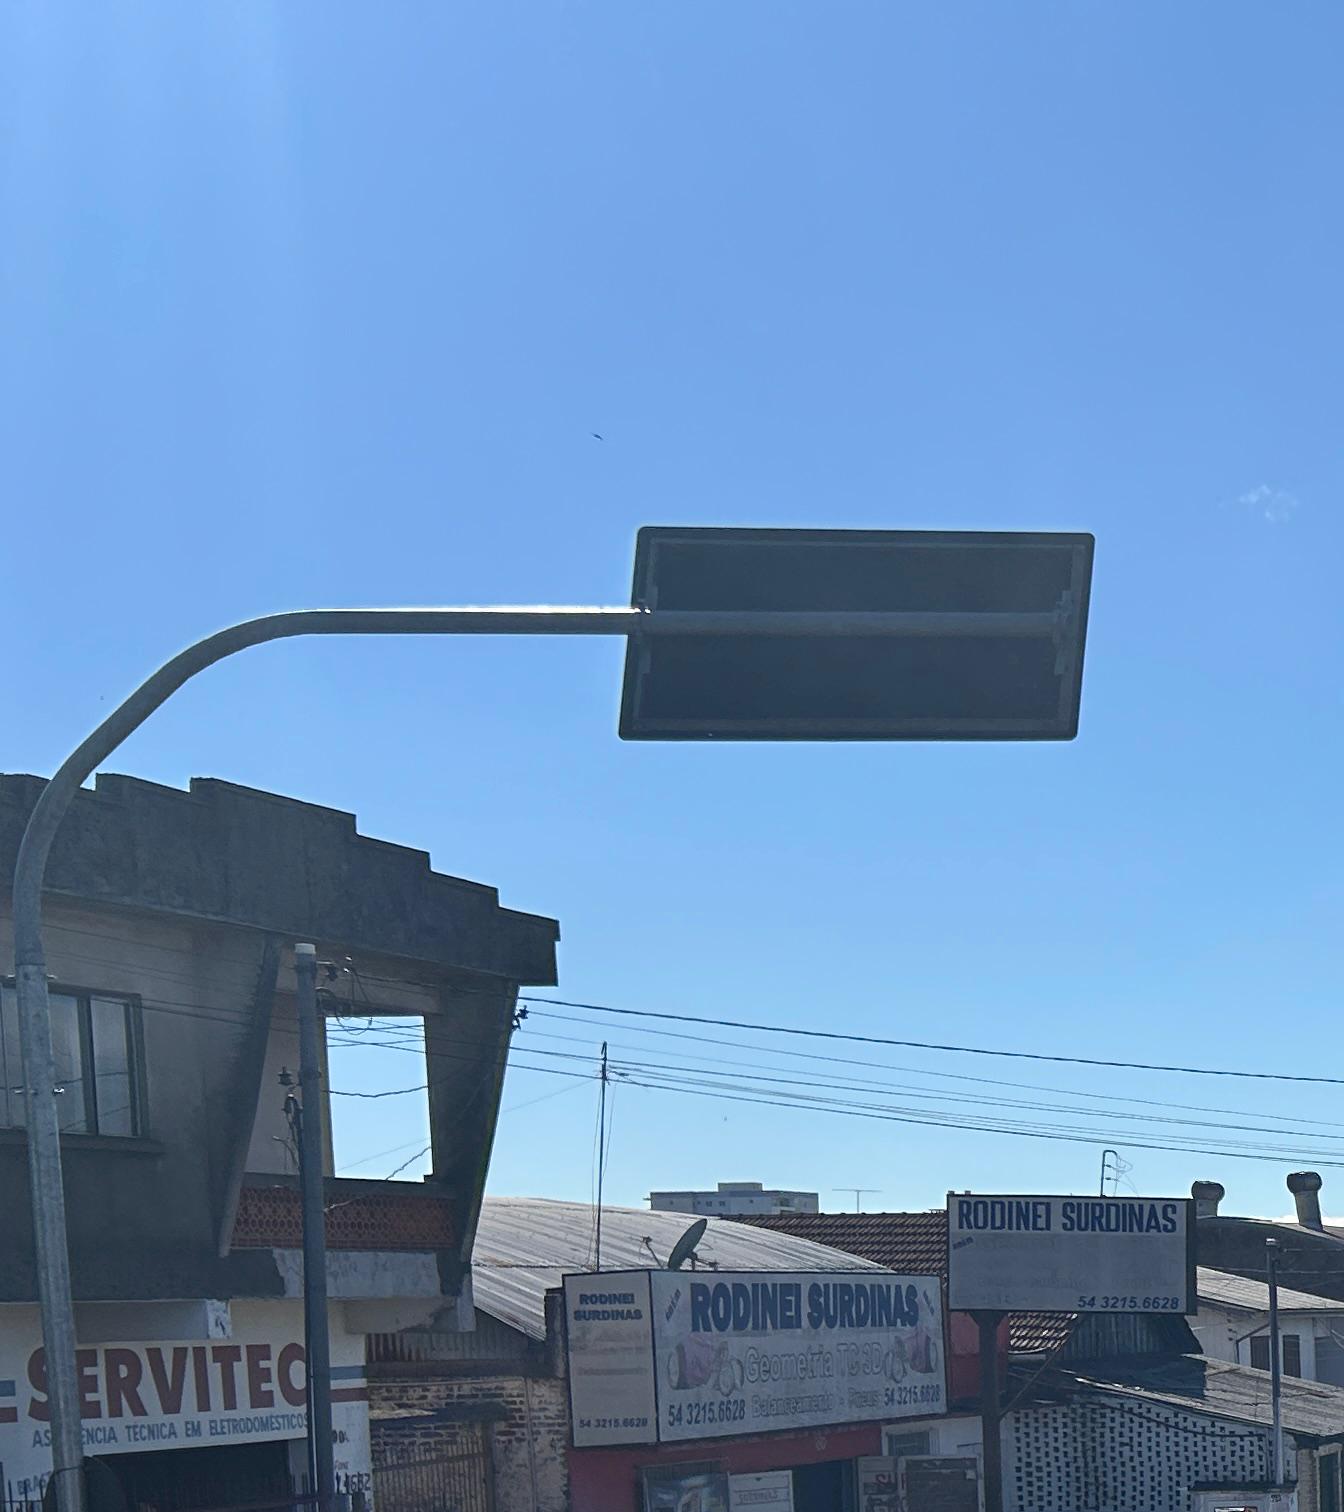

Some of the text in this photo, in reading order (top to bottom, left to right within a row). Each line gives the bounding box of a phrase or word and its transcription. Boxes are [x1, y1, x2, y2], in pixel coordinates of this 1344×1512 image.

[958, 1199, 1177, 1233] RODINEI SURDINAS
[579, 1292, 635, 1305] RODINEI
[691, 1282, 801, 1332] RODINEI
[807, 1283, 920, 1331] SURDINAS
[1078, 1295, 1180, 1310] 54 3215.6628
[573, 1308, 643, 1321] SURDINAS
[668, 1399, 746, 1427] 54 3215.6628
[32, 1426, 118, 1448] ASENCIA
[185, 1419, 203, 1438] EM
